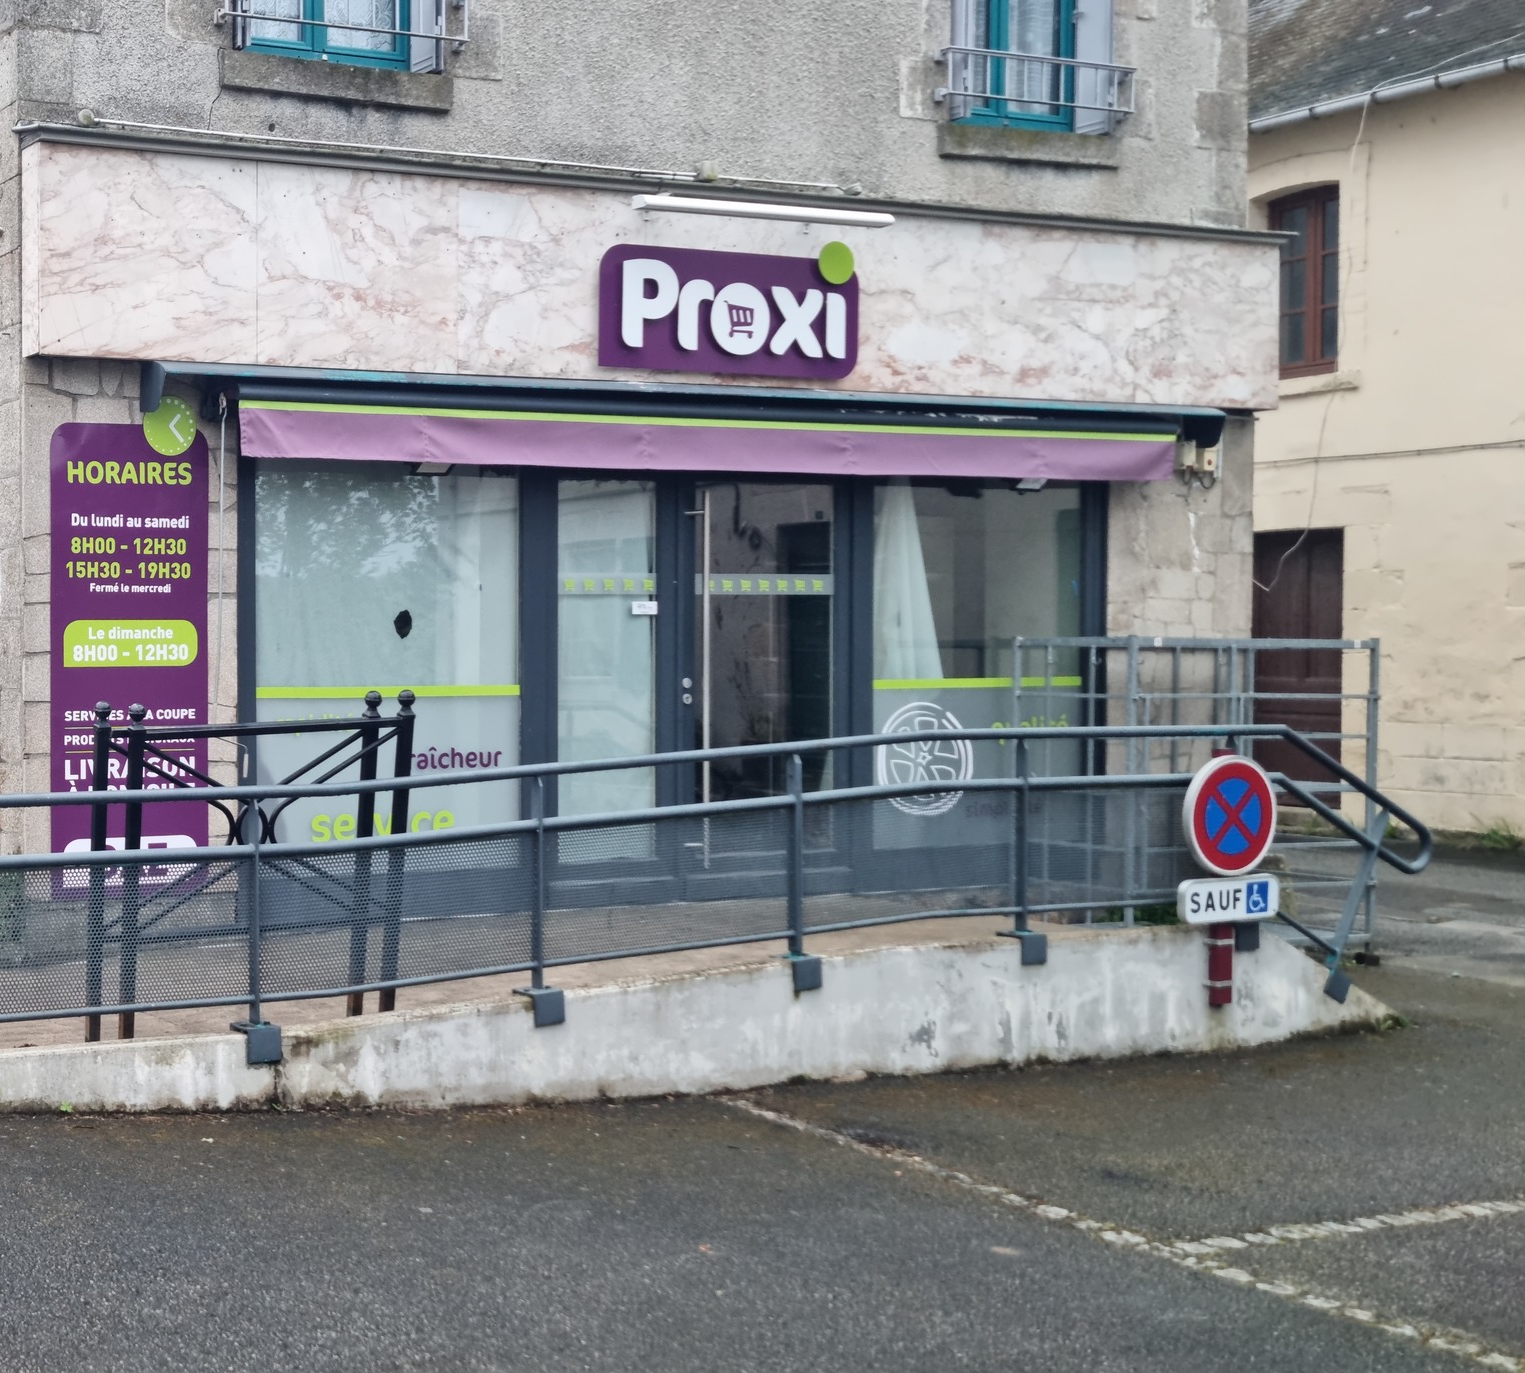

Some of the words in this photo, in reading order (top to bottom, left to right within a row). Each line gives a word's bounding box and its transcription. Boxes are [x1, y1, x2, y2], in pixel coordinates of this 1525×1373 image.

[622, 241, 854, 359] Proxi
[67, 460, 193, 486] HORAIRES
[71, 513, 88, 526] Du
[91, 514, 124, 527] lundi
[126, 518, 142, 528] au
[144, 516, 190, 529] samedi
[71, 537, 116, 554] 8H00
[133, 538, 187, 555] 12H30
[66, 561, 121, 578] 15H30
[138, 562, 191, 579] 19H30
[89, 582, 119, 593] Fermé
[121, 583, 130, 593] le
[131, 584, 172, 593] mercredi
[88, 627, 105, 640] Le
[108, 626, 174, 640] dimanche
[73, 645, 118, 662] 8H00
[135, 644, 189, 661] 12H30
[64, 710, 124, 721] SERVES
[156, 709, 196, 720] COUPE
[411, 747, 502, 770] aîcheur
[311, 810, 455, 843] sevce
[1190, 889, 1242, 914] SAUF
